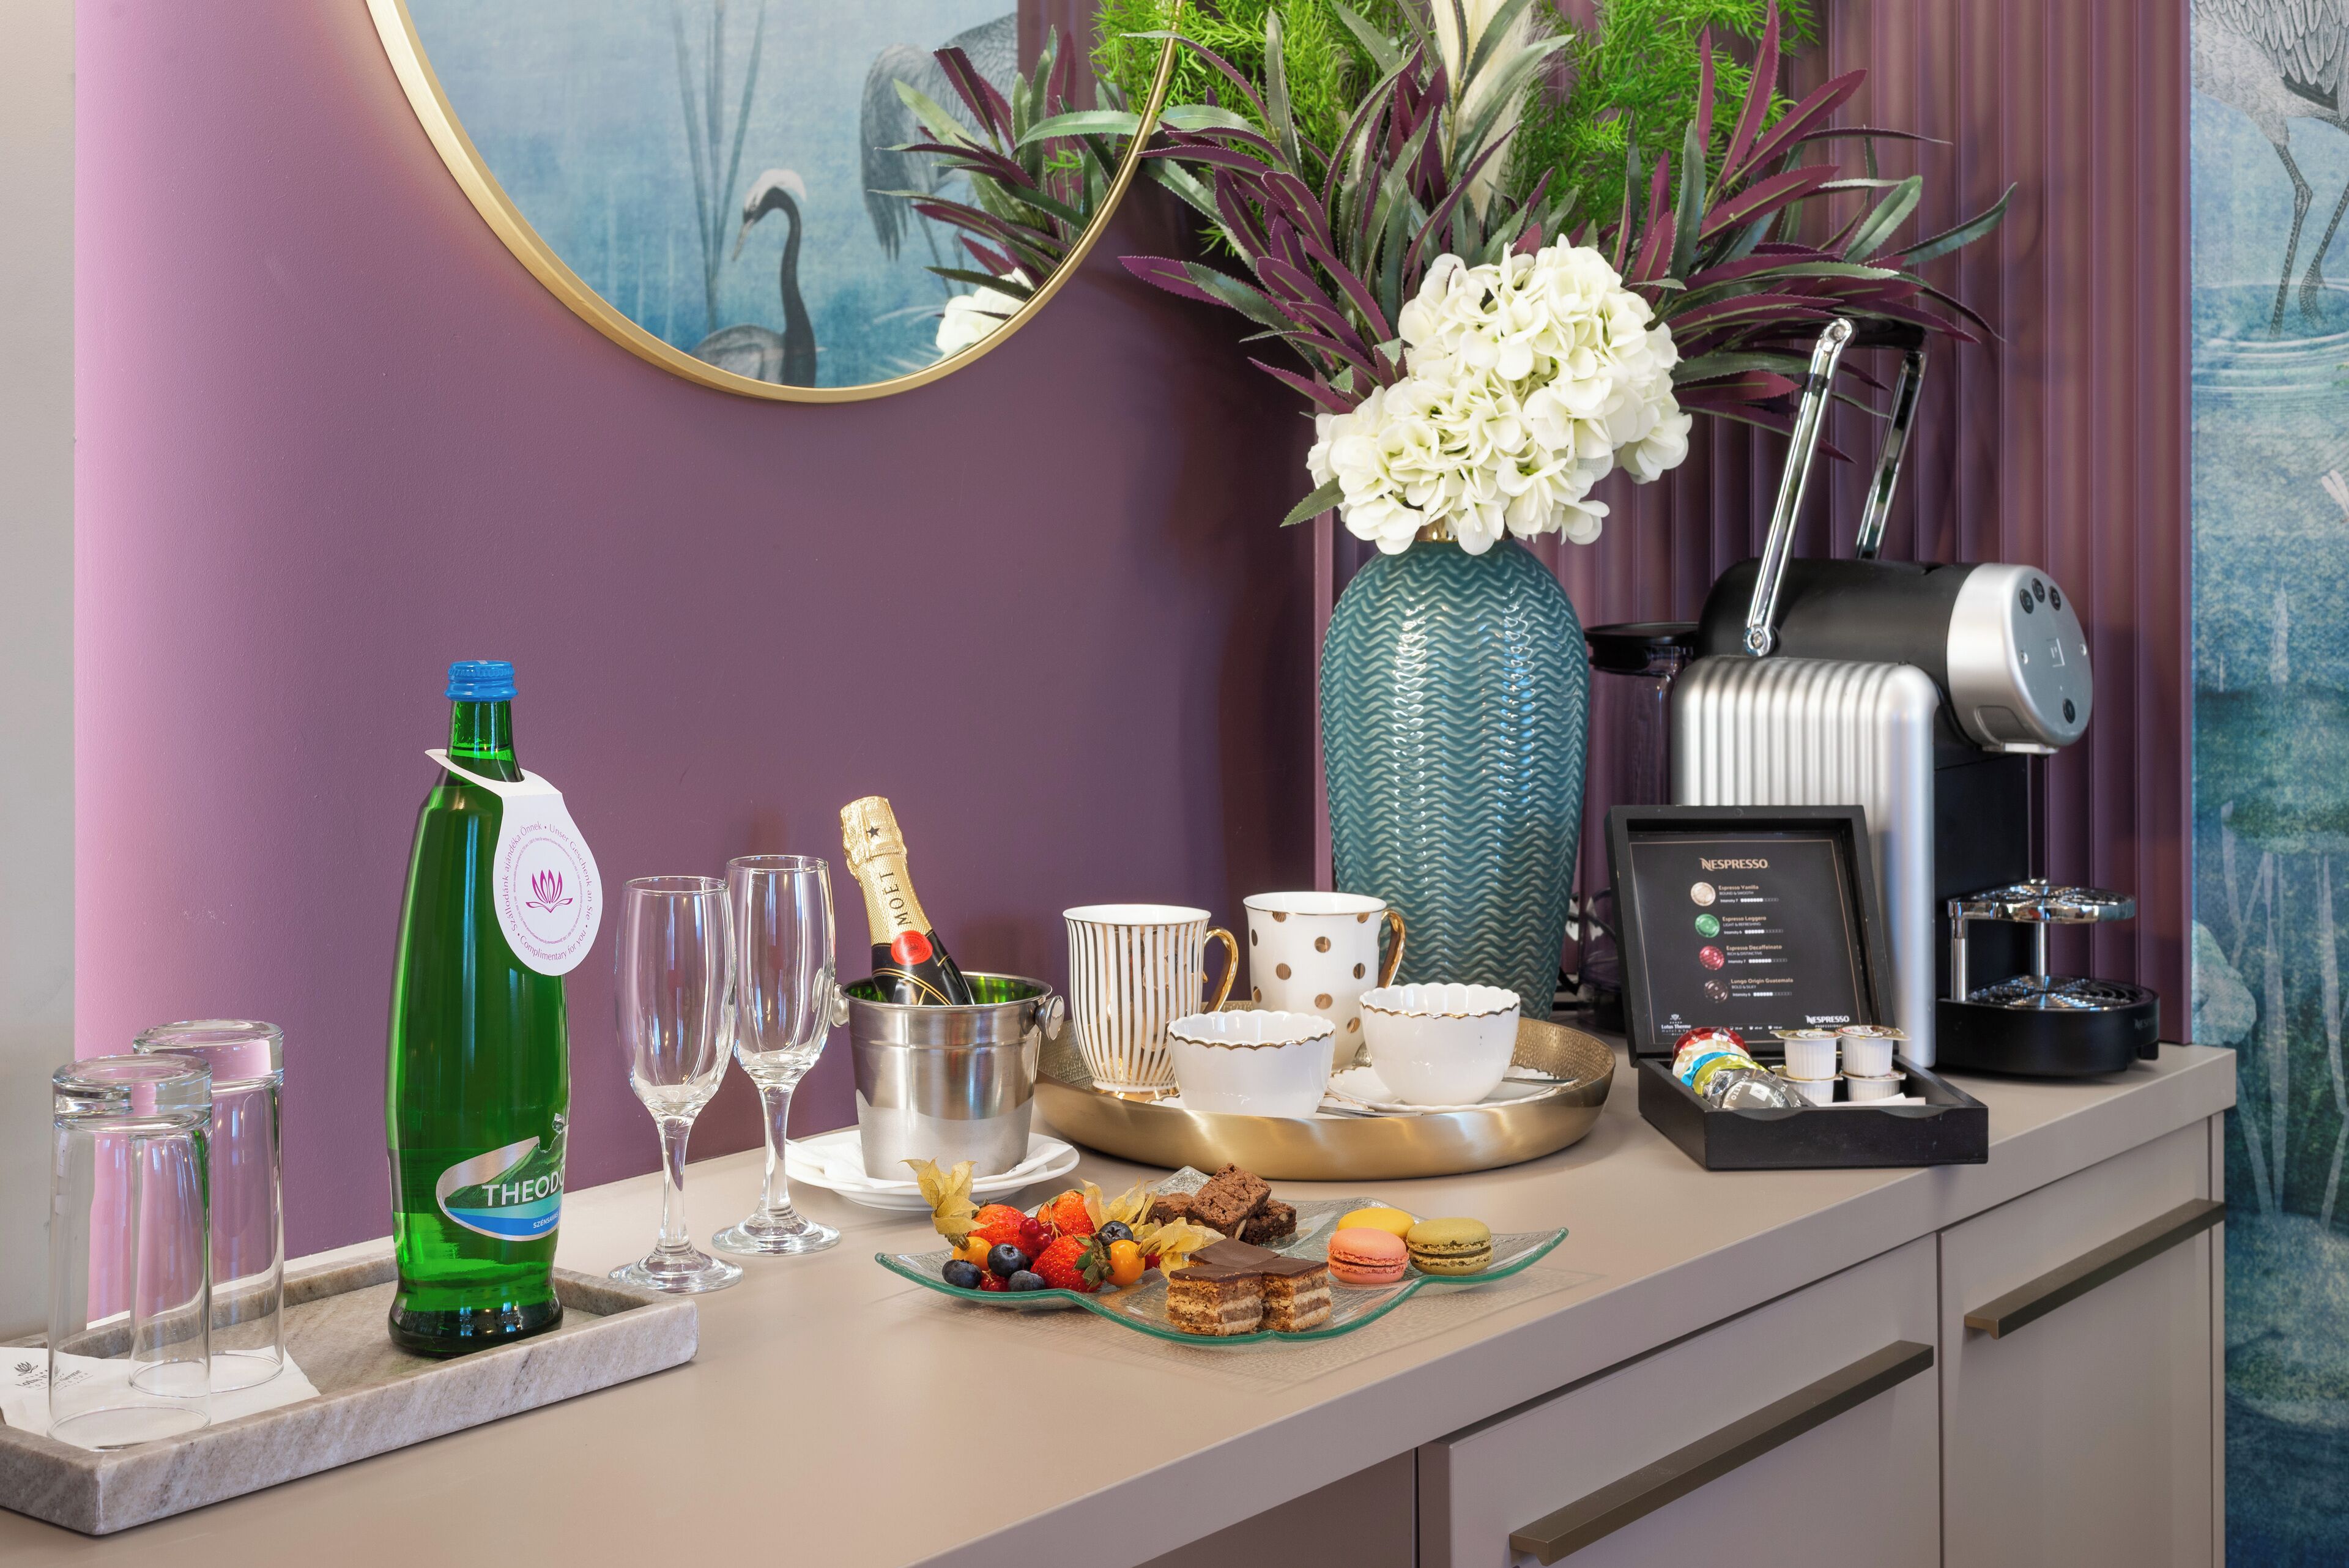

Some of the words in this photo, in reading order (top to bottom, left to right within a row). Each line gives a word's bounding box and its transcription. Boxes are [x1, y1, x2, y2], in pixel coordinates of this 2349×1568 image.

[521, 820, 542, 836] Önnek
[504, 834, 521, 872] ajándéka
[549, 823, 568, 842] Unser
[570, 841, 592, 886] Geschenk
[587, 890, 592, 902] an
[1699, 858, 1768, 871] NESPRESSO
[502, 875, 518, 931] Szállodánk
[879, 872, 911, 926] MOËT
[520, 935, 567, 960] Complimentary
[568, 943, 576, 954] for
[576, 930, 586, 946] you
[1805, 1015, 1850, 1025] NESPRESSO
[533, 1211, 558, 1228] SZÉNSAVAS
